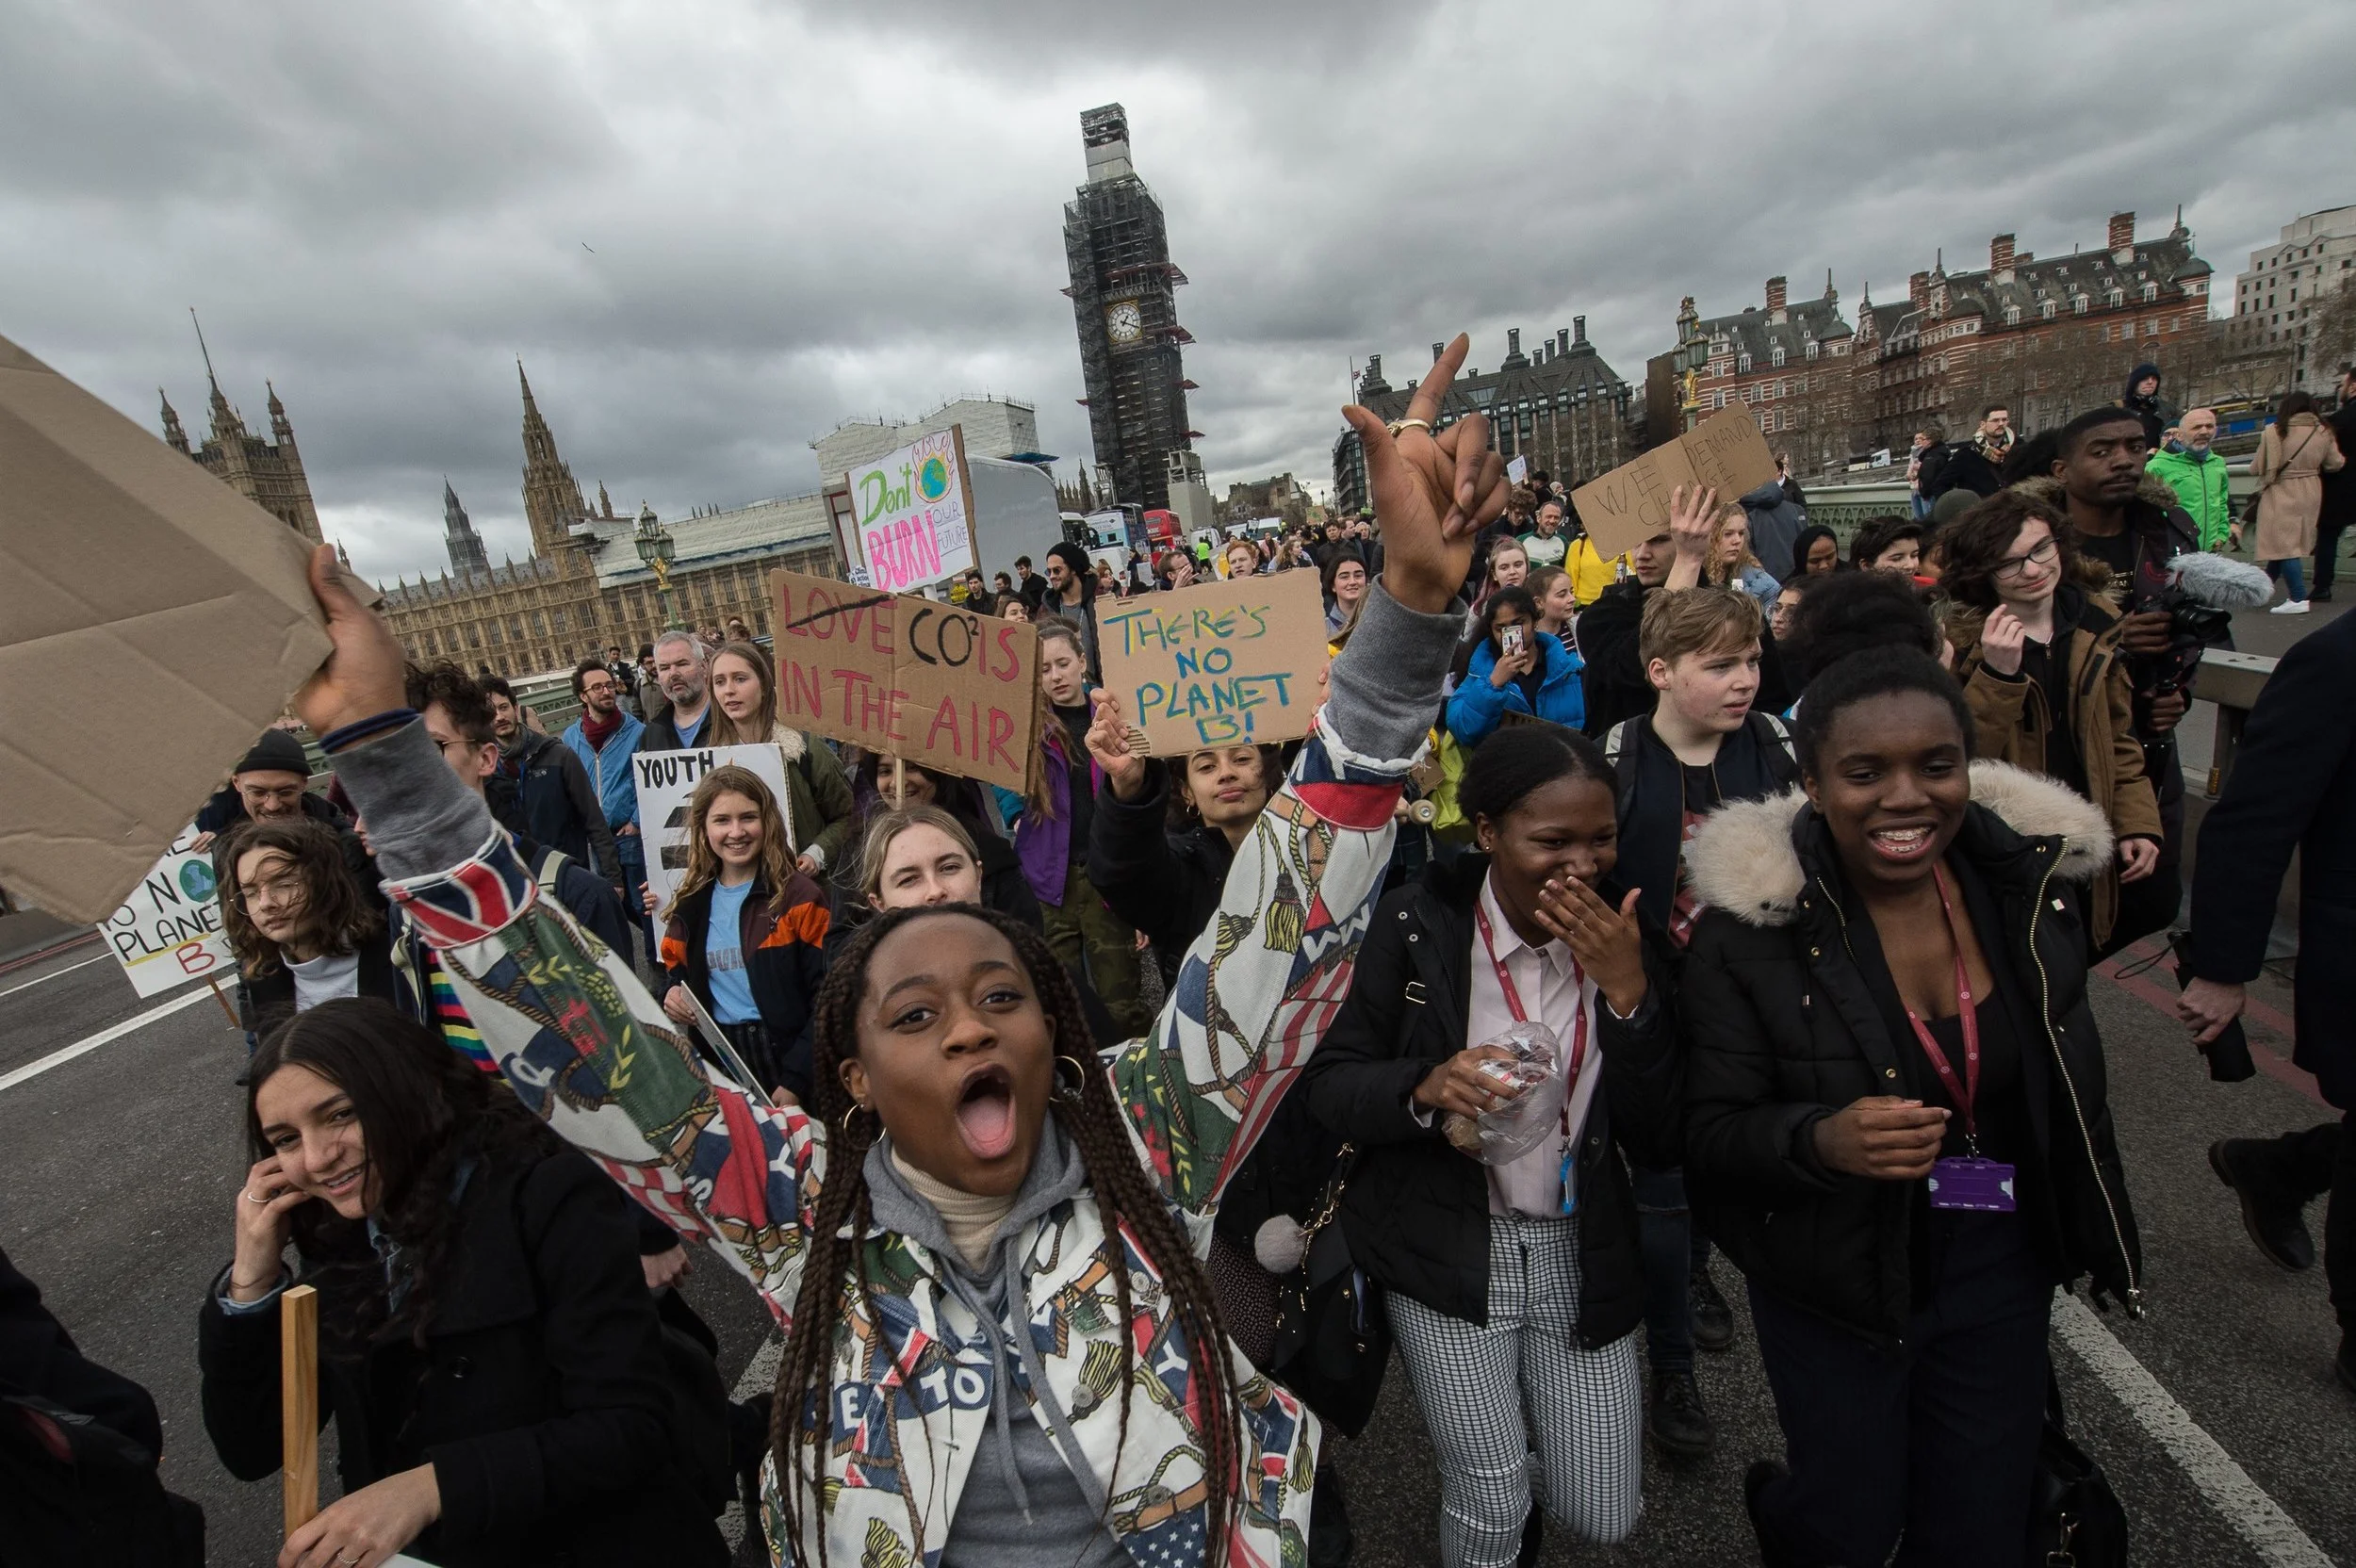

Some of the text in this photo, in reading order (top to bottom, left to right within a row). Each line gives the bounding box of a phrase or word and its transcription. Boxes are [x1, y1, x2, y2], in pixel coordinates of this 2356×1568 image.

[1594, 414, 1753, 517] WE DEMAND
[859, 462, 912, 528] Don't
[933, 500, 961, 524] OUR
[867, 510, 941, 593] BURN
[937, 525, 969, 551] FUTURE
[783, 583, 898, 655] LOVE
[978, 621, 1021, 683] IS
[1103, 604, 1271, 658] THERE'S
[1174, 645, 1234, 679] NO
[781, 659, 1021, 774] IN THE AIR
[1136, 672, 1295, 727] PLANET
[1195, 710, 1255, 744] B!
[636, 750, 715, 790] YOUTH
[112, 898, 223, 962] PLANE
[174, 941, 216, 975] B
